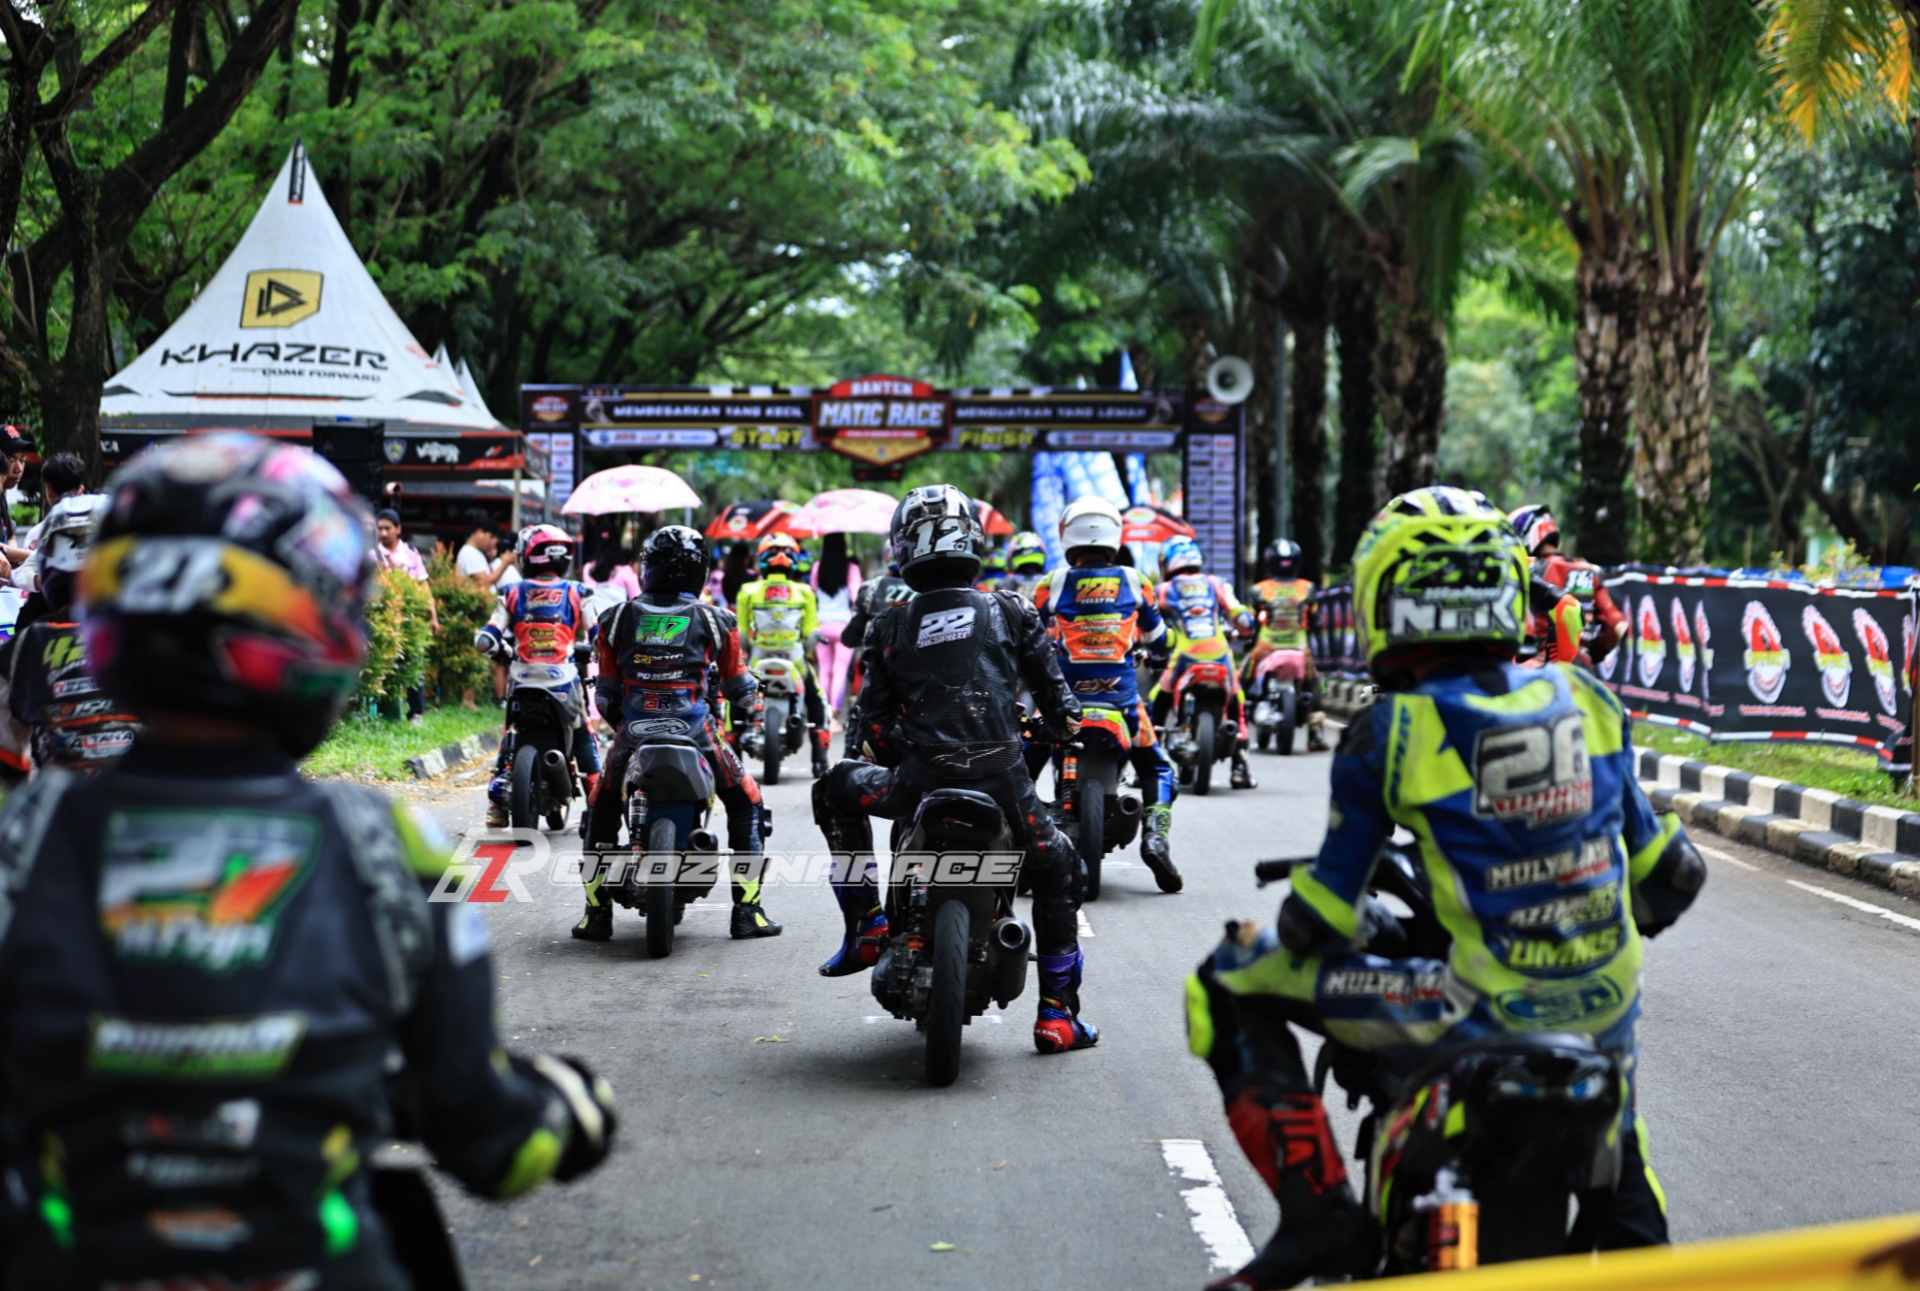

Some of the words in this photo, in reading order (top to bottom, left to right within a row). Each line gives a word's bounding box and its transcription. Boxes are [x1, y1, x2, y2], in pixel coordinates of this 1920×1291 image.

[160, 342, 389, 371] KHAZER
[309, 369, 381, 382] FORWARD
[851, 380, 913, 397] BANTEN
[818, 401, 885, 427] MATIC
[886, 401, 945, 428] RACE
[731, 429, 805, 446] START
[958, 429, 1034, 446] FINISH
[912, 516, 967, 558] 12
[1075, 577, 1122, 603] 225
[920, 606, 977, 640] 22
[1479, 712, 1591, 812] 26
